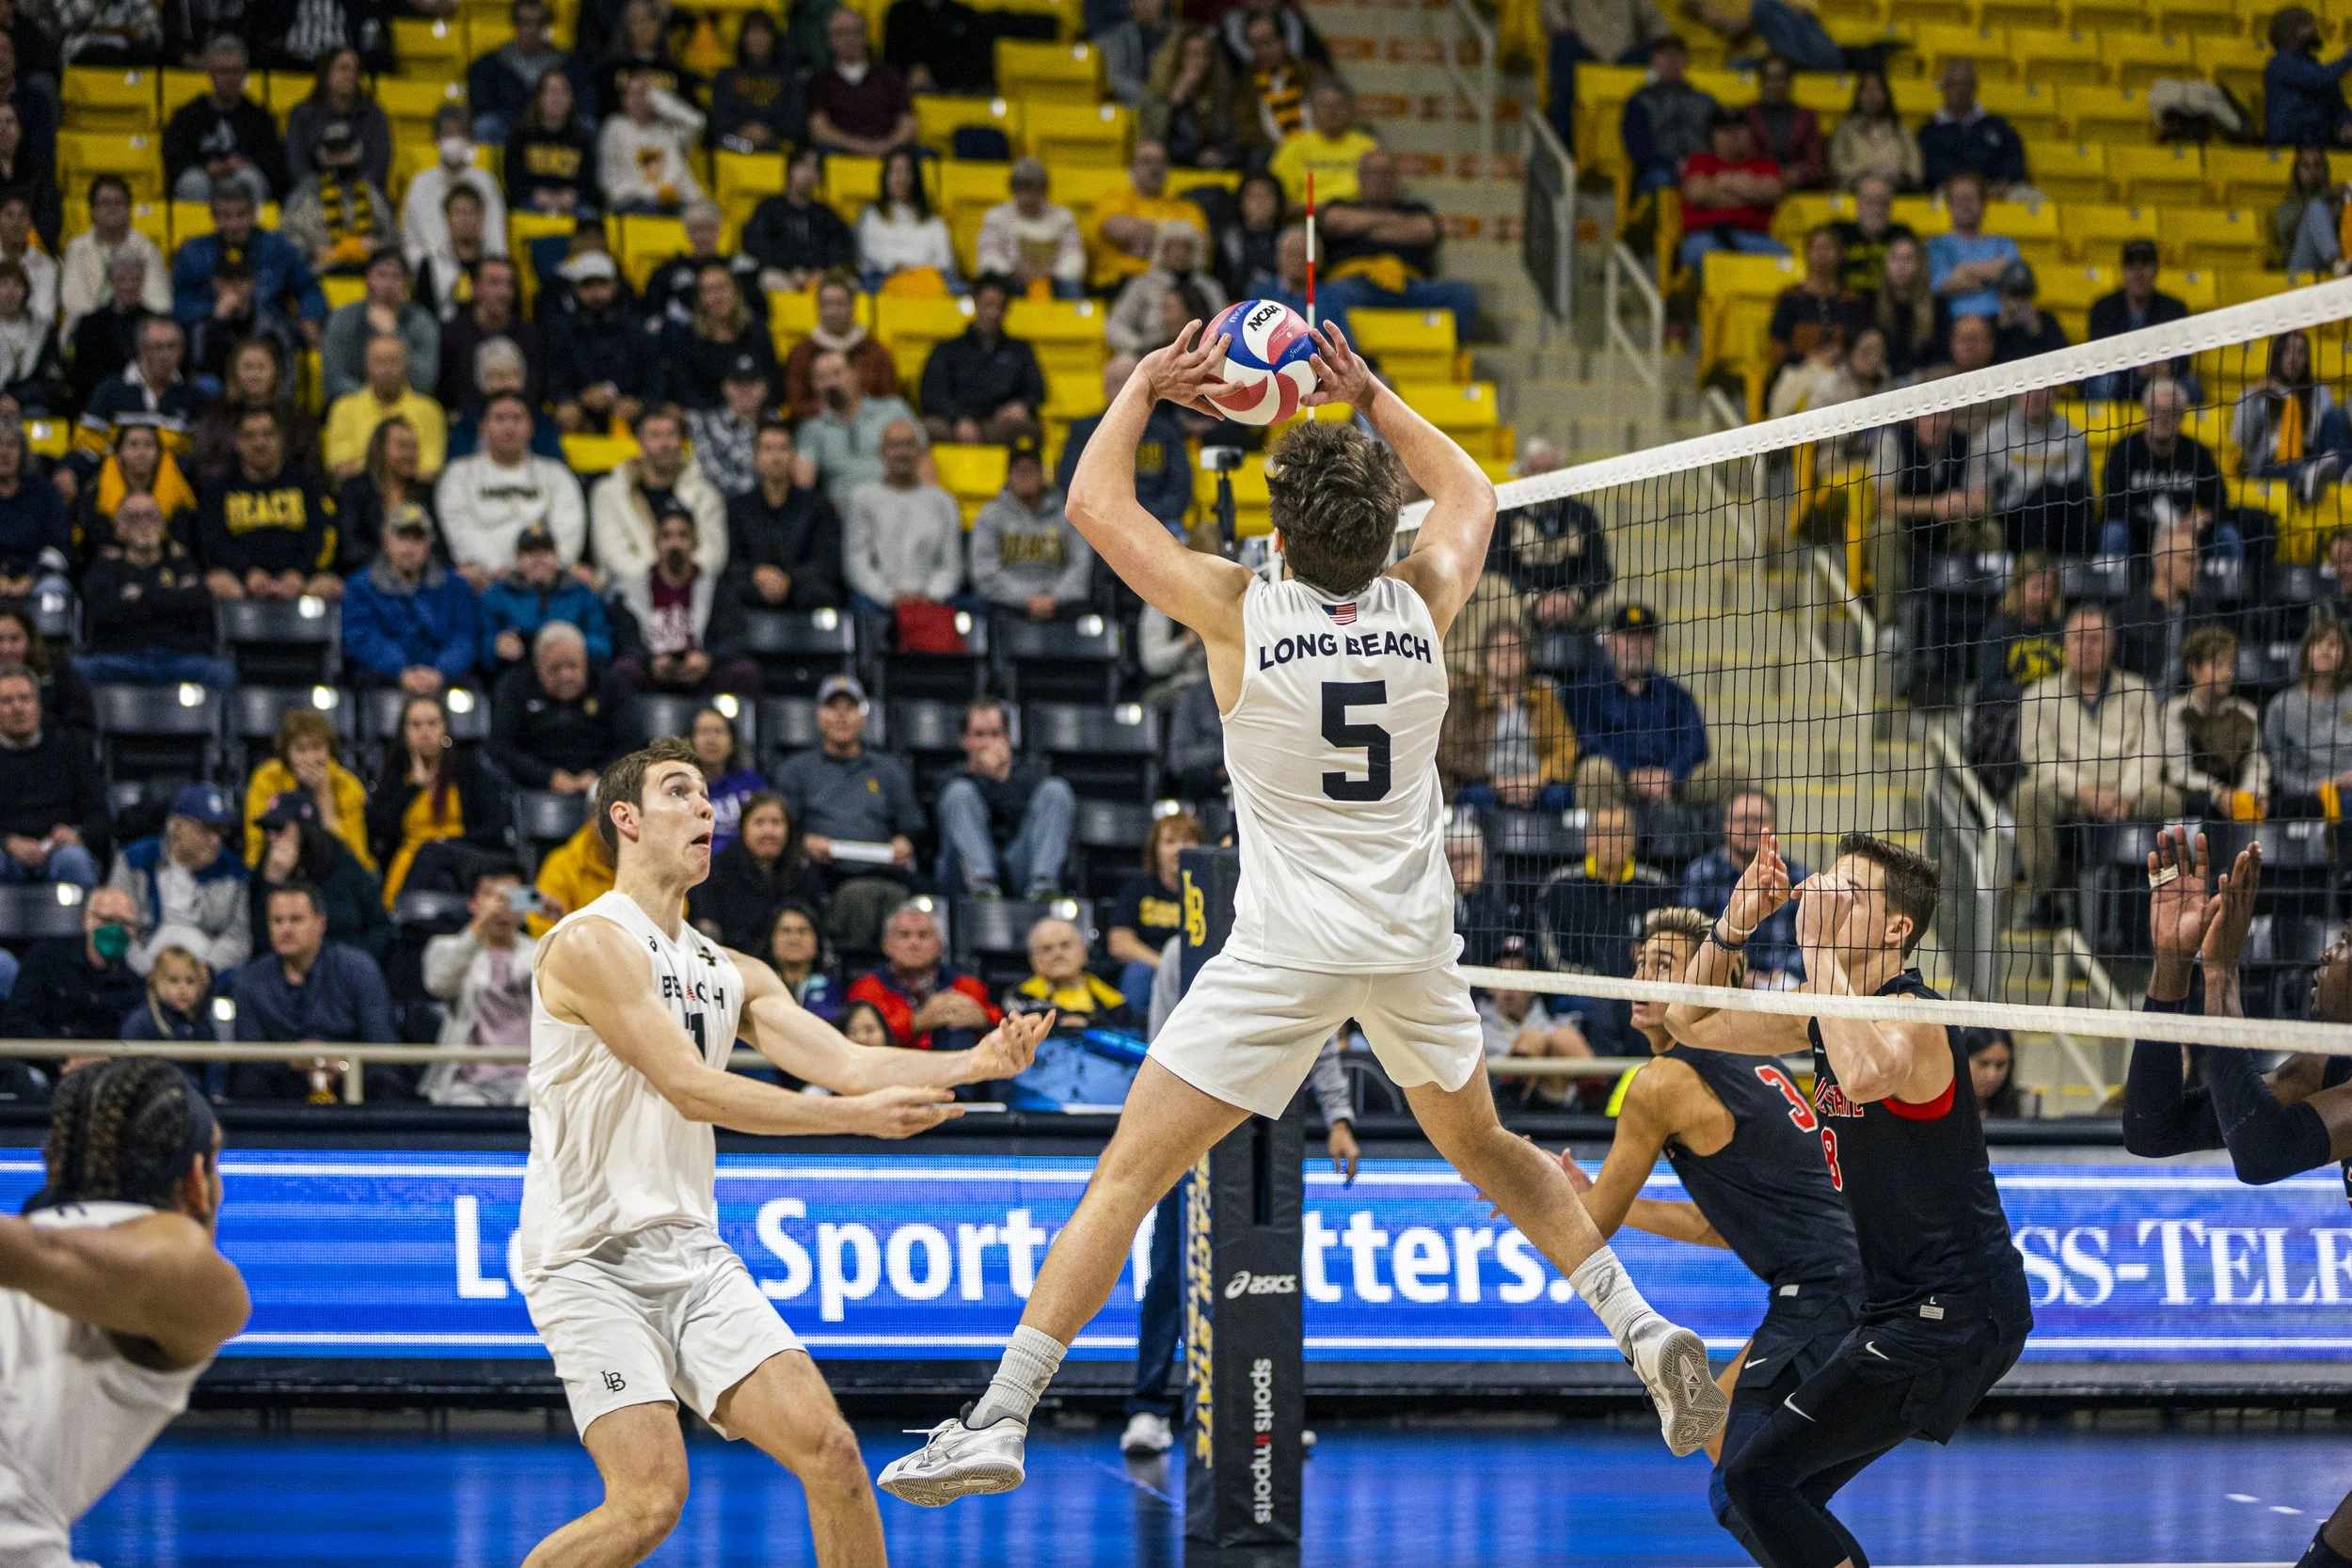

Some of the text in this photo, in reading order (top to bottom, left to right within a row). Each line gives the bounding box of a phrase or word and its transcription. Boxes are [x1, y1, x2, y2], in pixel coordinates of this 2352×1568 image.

[1247, 305, 1281, 331] NCAA
[1260, 631, 1431, 671] LONG BEACH
[1321, 680, 1391, 801] 5
[1755, 1065, 1818, 1132] 3
[1821, 1127, 1843, 1192] 8
[755, 1196, 1063, 1322] Sport
[1249, 1358, 1274, 1433] sports
